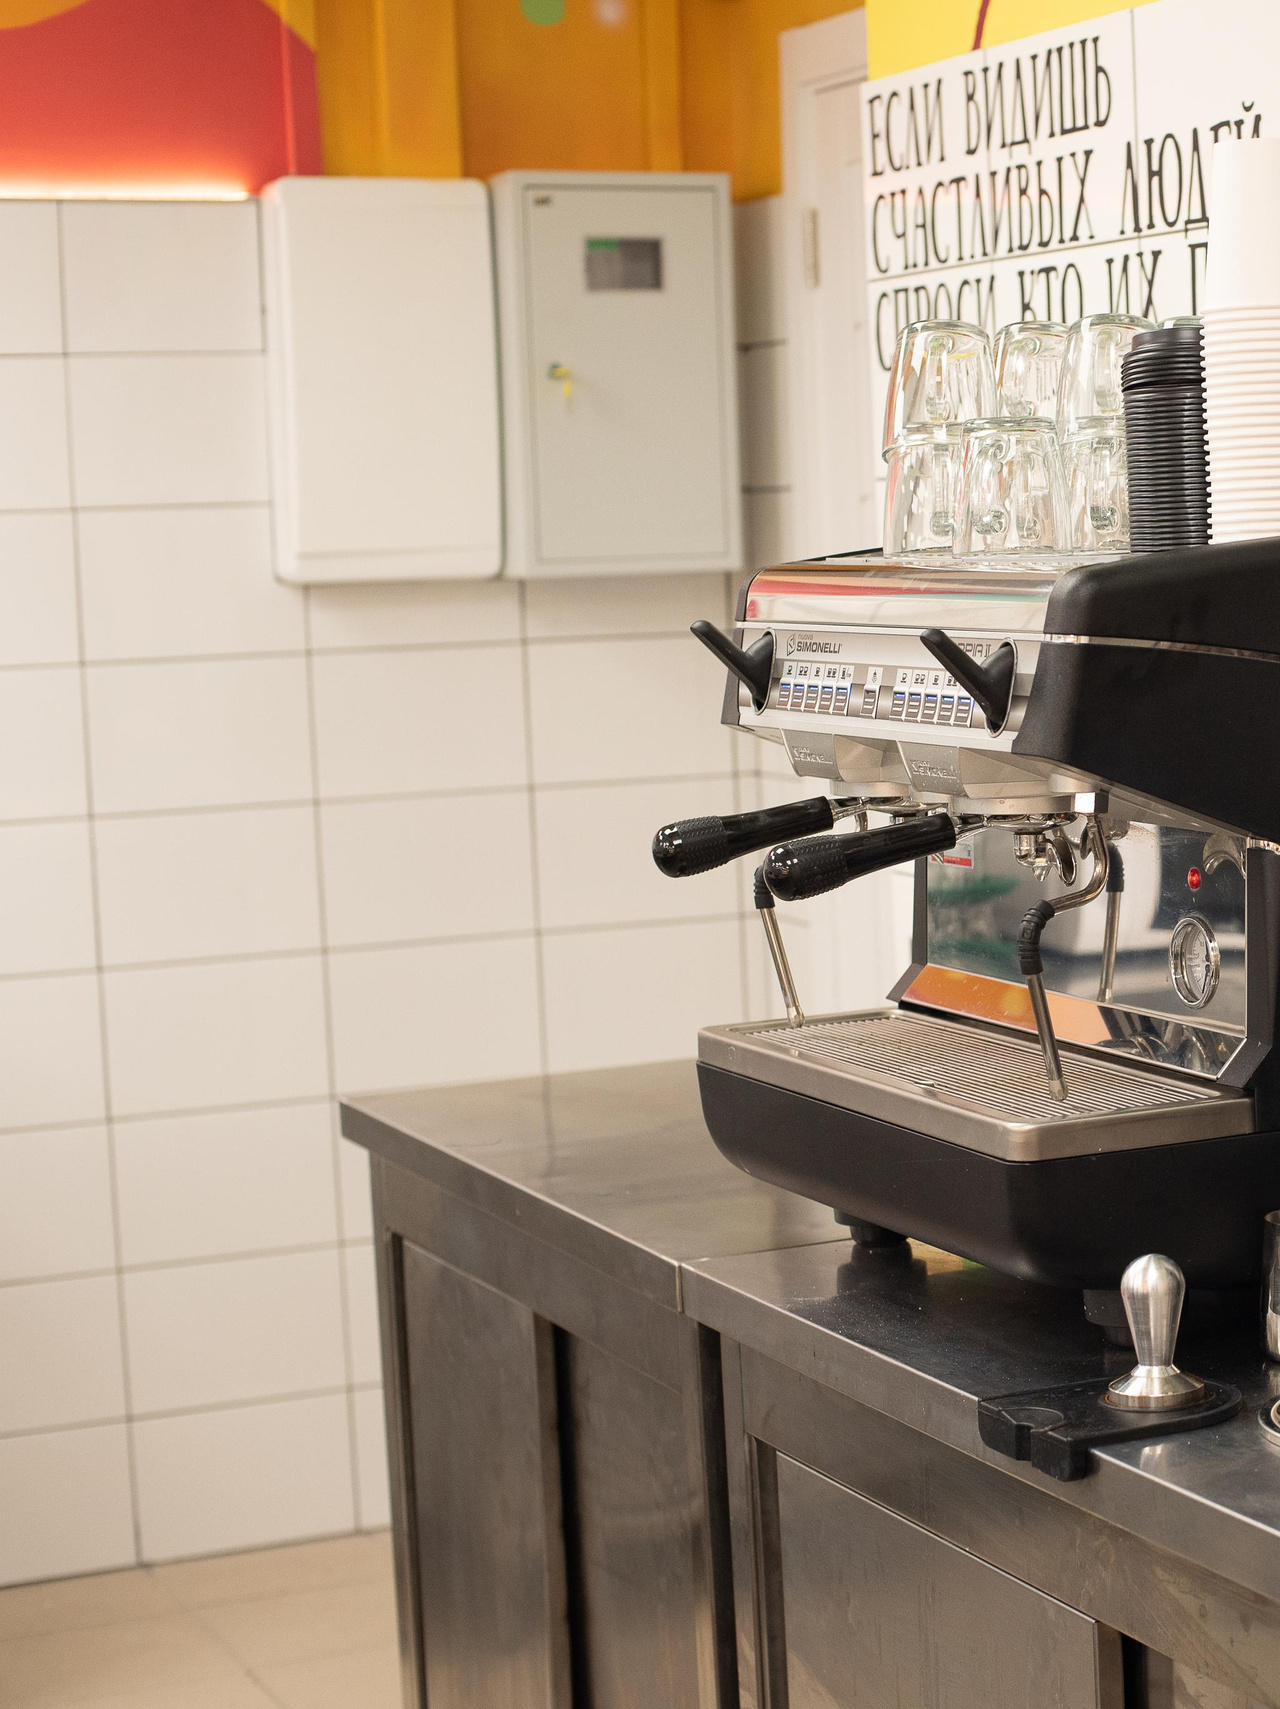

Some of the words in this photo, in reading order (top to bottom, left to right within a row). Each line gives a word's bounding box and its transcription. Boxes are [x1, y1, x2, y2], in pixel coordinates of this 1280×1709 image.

[868, 78, 945, 177] ЕСЛИ
[963, 36, 1112, 159] ВИДИШЬ
[872, 149, 1095, 273] СЧАСТЛИВЫХ
[1120, 101, 1262, 239] ЛЮД
[1106, 250, 1162, 324] ИХ
[796, 641, 841, 654] SIMONELLI
